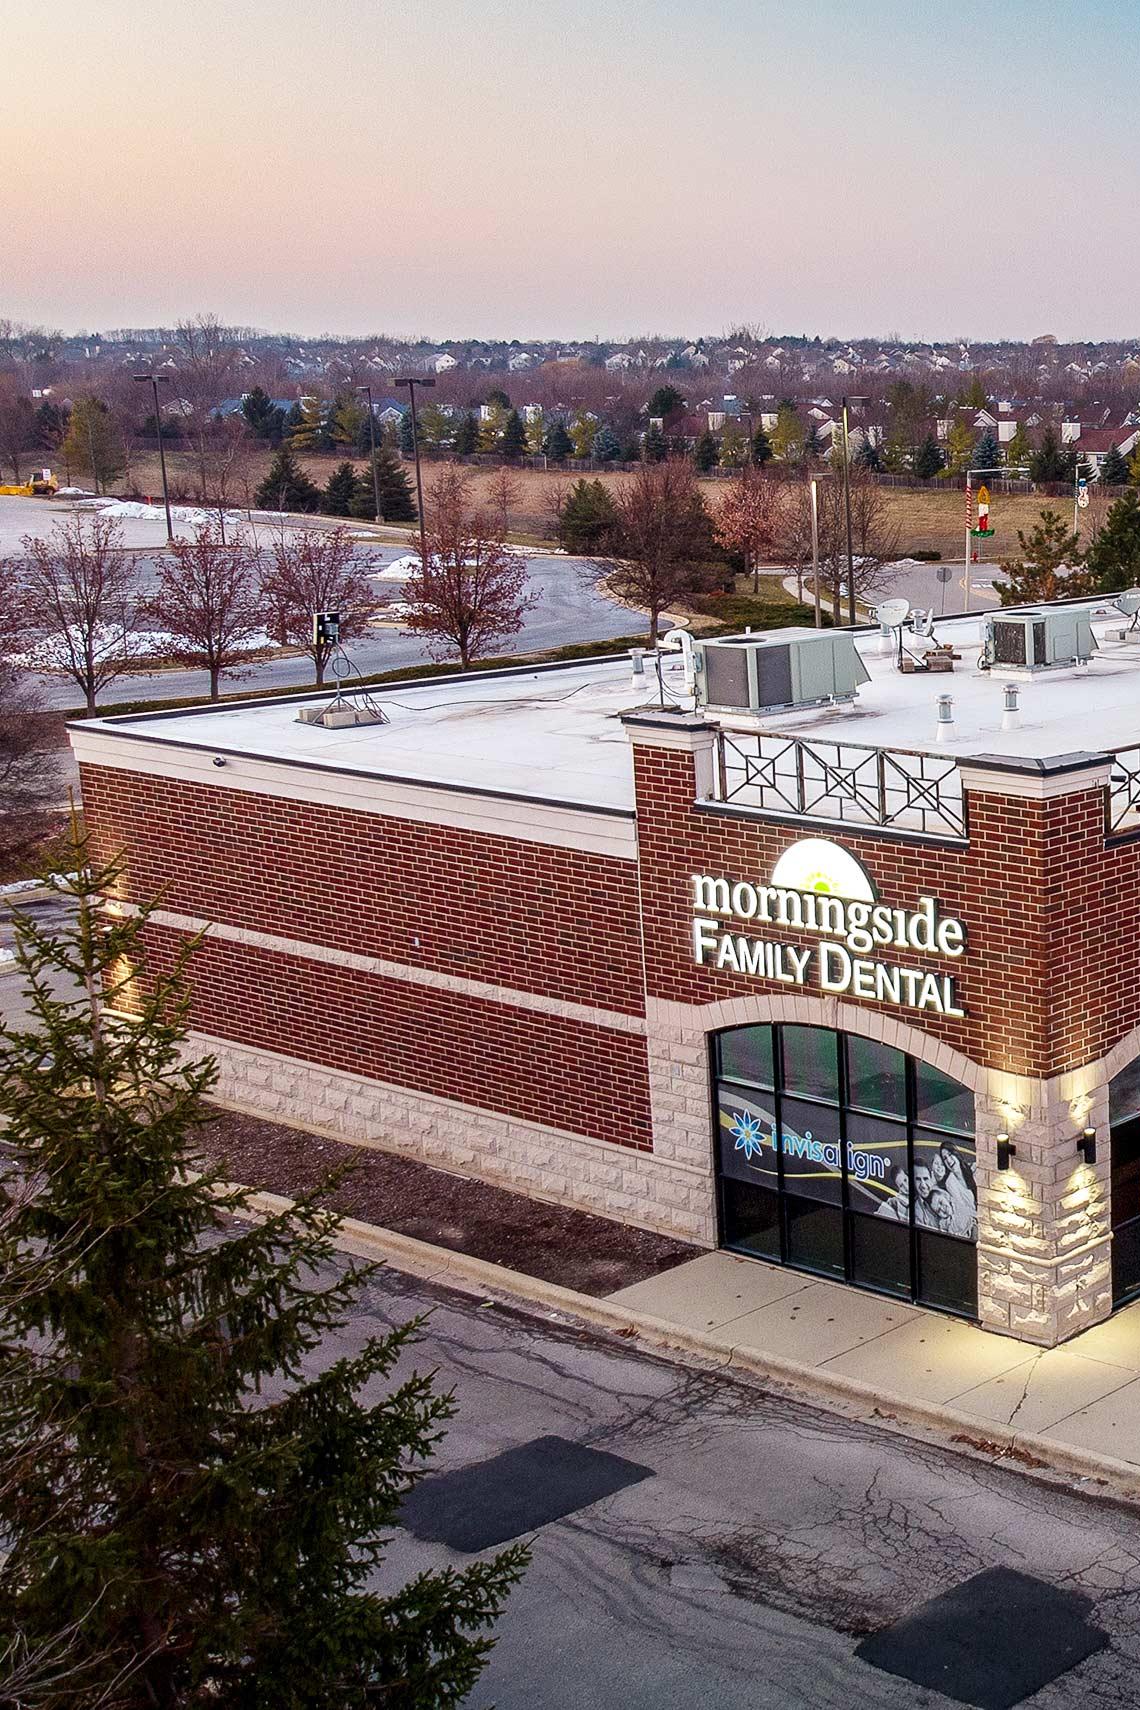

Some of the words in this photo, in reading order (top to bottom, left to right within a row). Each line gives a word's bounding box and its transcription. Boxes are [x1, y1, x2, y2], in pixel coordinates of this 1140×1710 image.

[690, 873, 966, 957] morningside
[692, 917, 812, 985] FAMILY
[819, 941, 966, 1017] DENTAL
